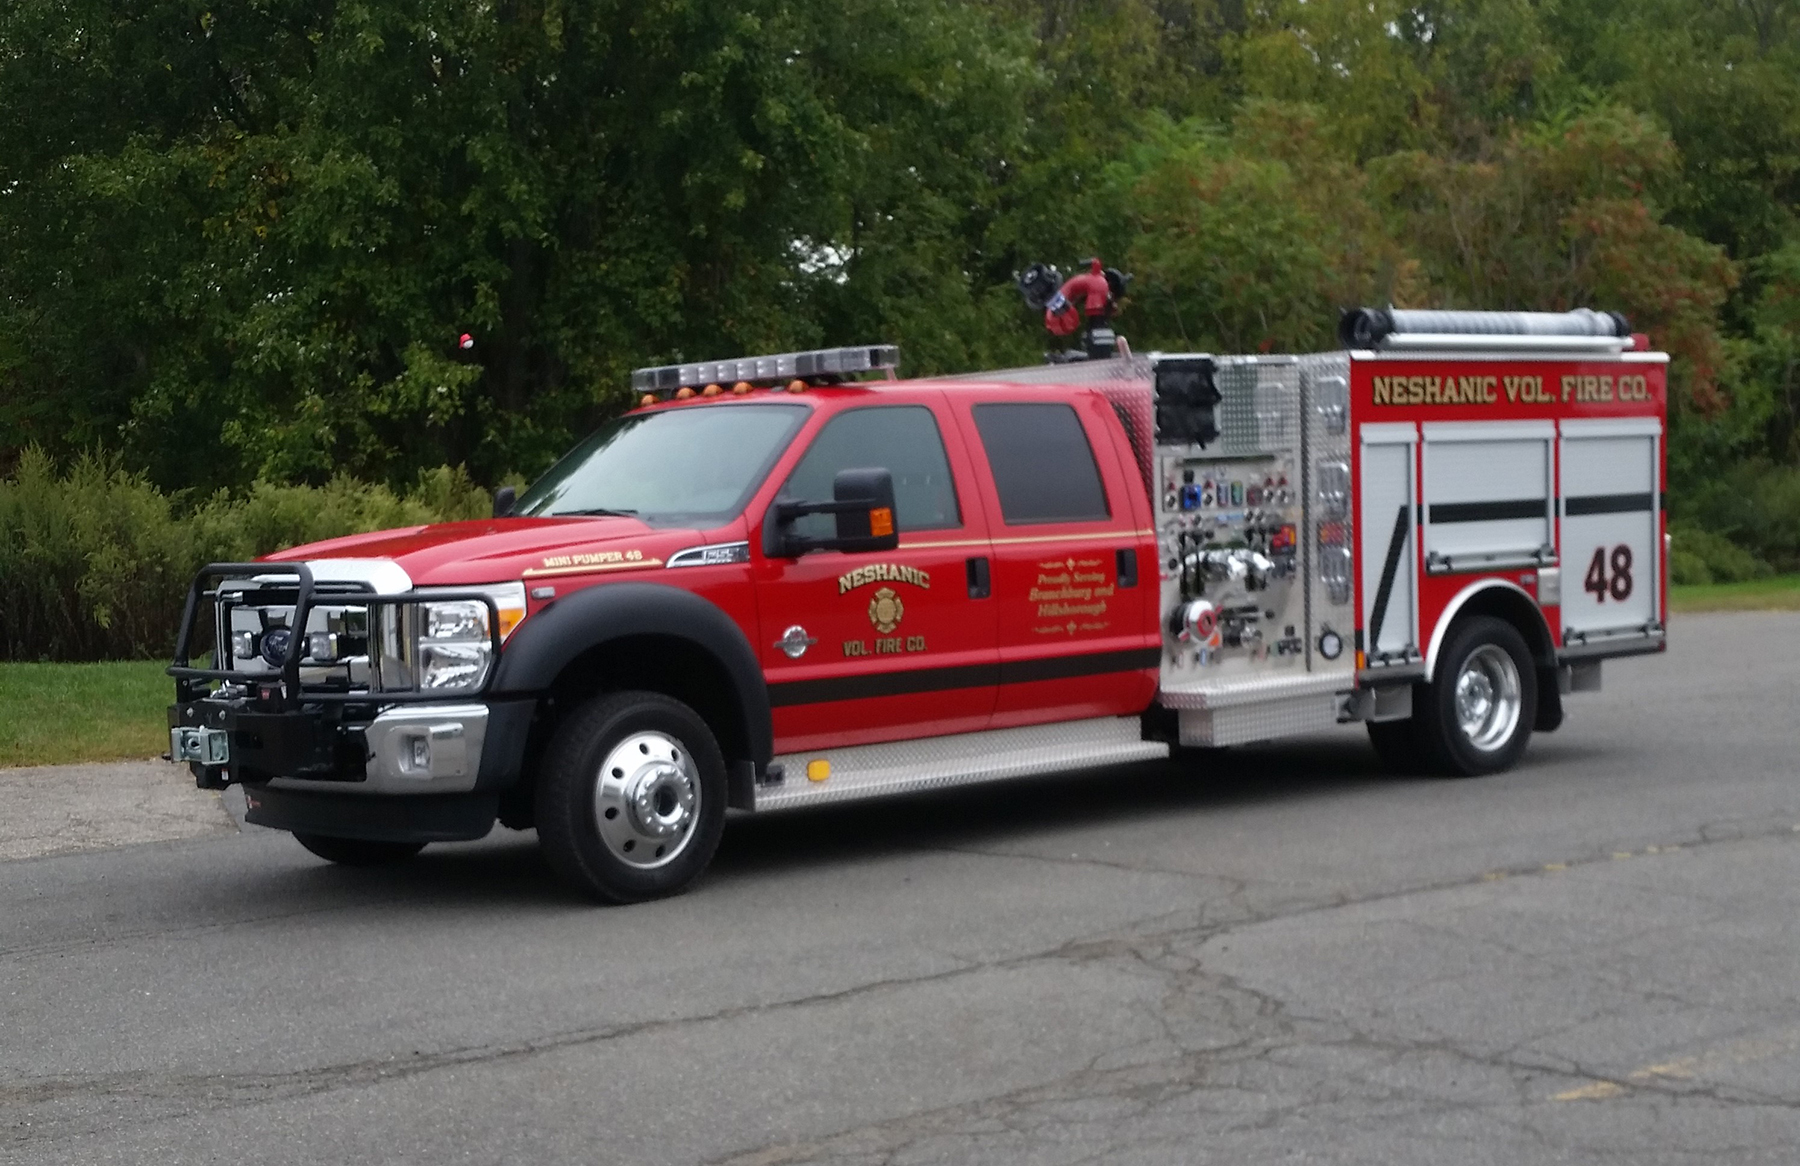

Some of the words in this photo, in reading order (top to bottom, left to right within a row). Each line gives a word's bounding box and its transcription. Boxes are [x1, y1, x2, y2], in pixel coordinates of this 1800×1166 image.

[1373, 376, 1498, 405] NESHANIC
[1503, 376, 1555, 403] VOL.
[1560, 375, 1614, 402] FIRE
[1618, 375, 1651, 400] CO.
[543, 556, 572, 568] MINI
[573, 551, 624, 565] PUMPER
[625, 550, 643, 561] 48
[1584, 545, 1633, 603] 48
[838, 563, 930, 595] NESHANIC
[843, 640, 872, 657] VOL.
[875, 638, 902, 655] FIRE
[906, 635, 928, 652] CO.
